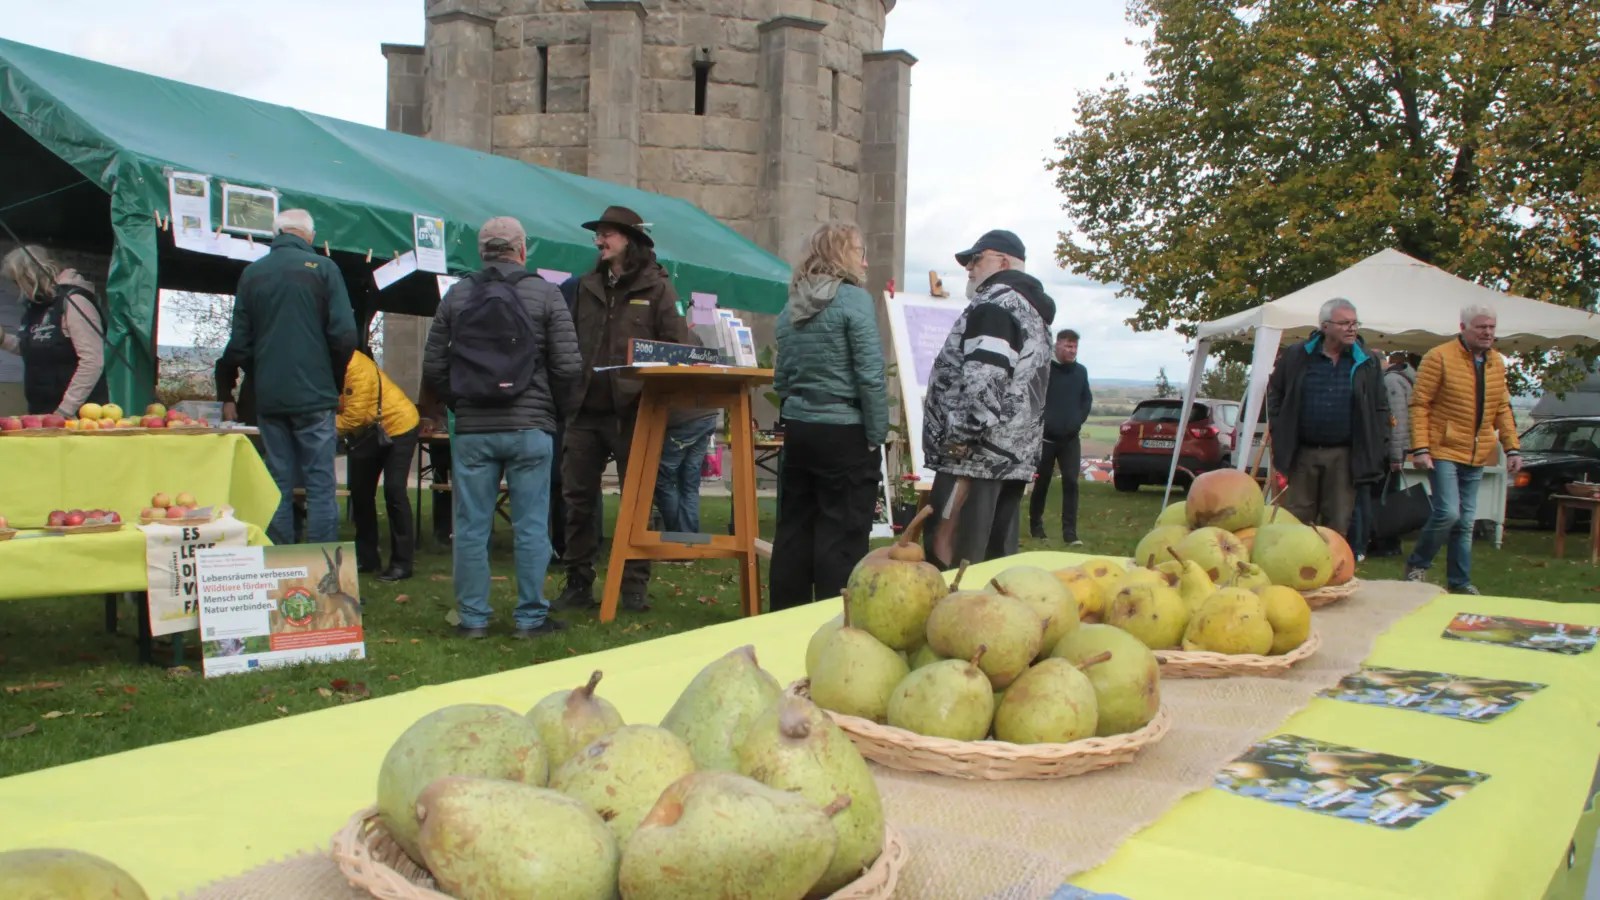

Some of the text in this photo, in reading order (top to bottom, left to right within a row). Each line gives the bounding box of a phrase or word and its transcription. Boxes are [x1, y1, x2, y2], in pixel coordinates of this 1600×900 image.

[182, 527, 200, 541] ES
[202, 569, 306, 583] Lebensräume verbessern.
[203, 581, 275, 593] Wildtiere fördern.
[203, 592, 254, 604] Mensch und
[204, 602, 275, 614] Natur verbinden.
